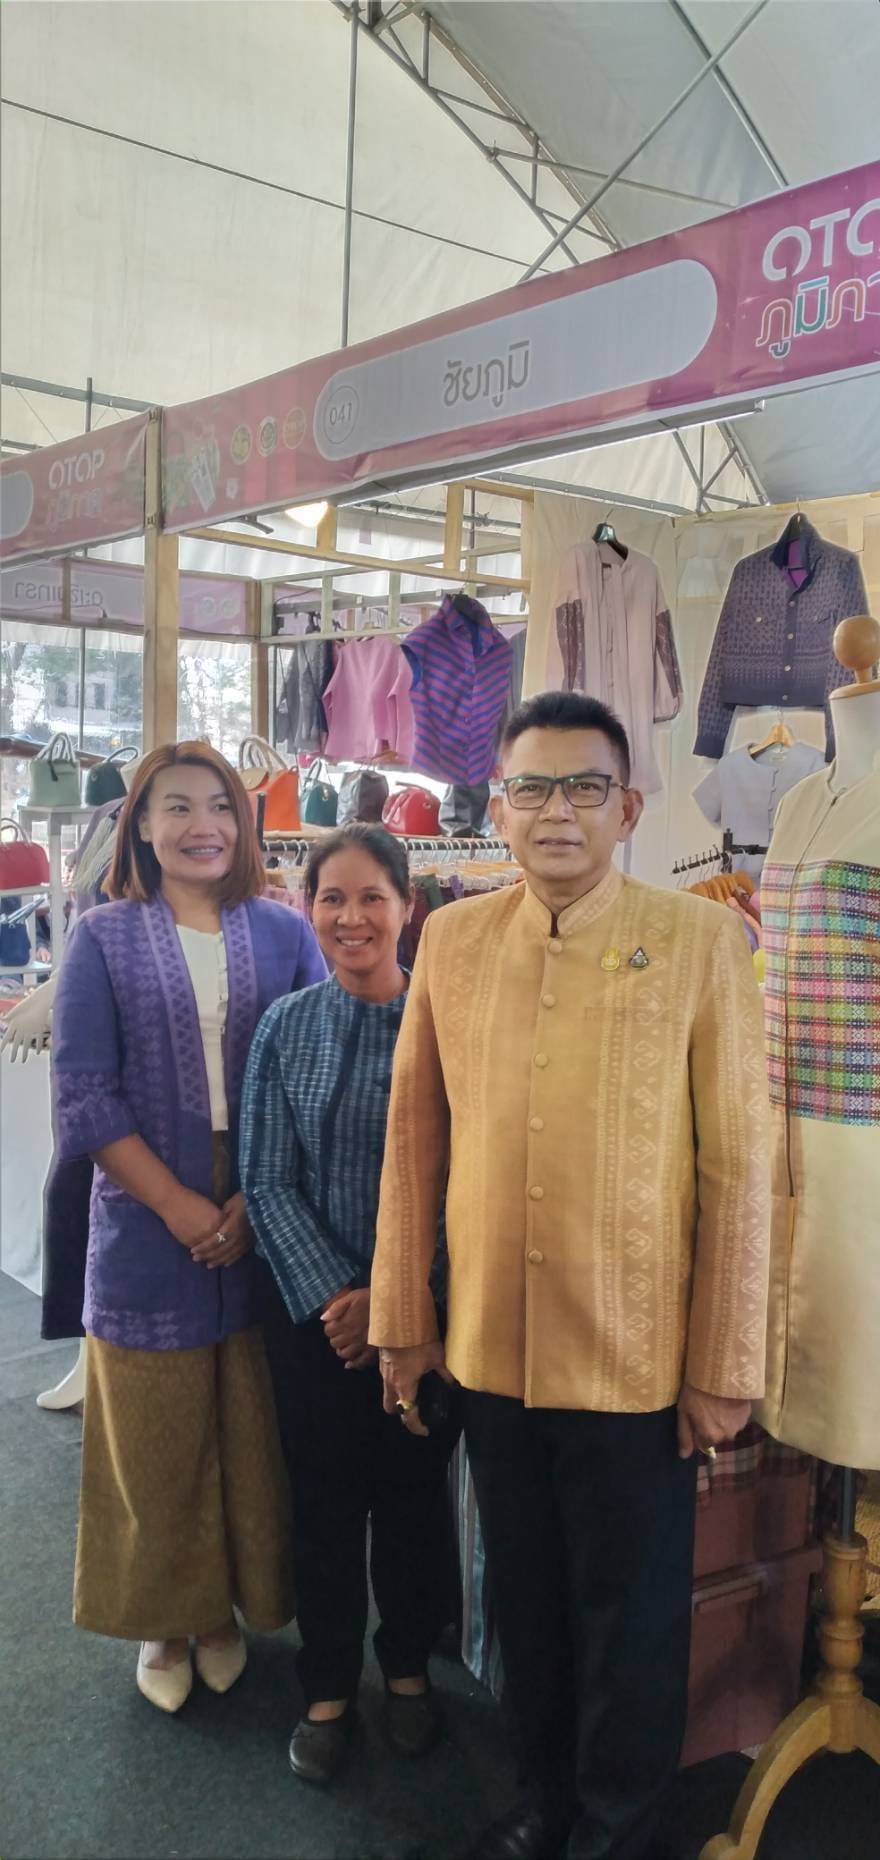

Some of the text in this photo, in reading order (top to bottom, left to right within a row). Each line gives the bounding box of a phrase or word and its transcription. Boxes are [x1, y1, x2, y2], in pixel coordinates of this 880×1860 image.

[755, 271, 880, 358] ภูมิภ
[442, 340, 531, 407] ชัยภูมิ
[329, 402, 353, 426] 041
[49, 450, 105, 489] OTOP
